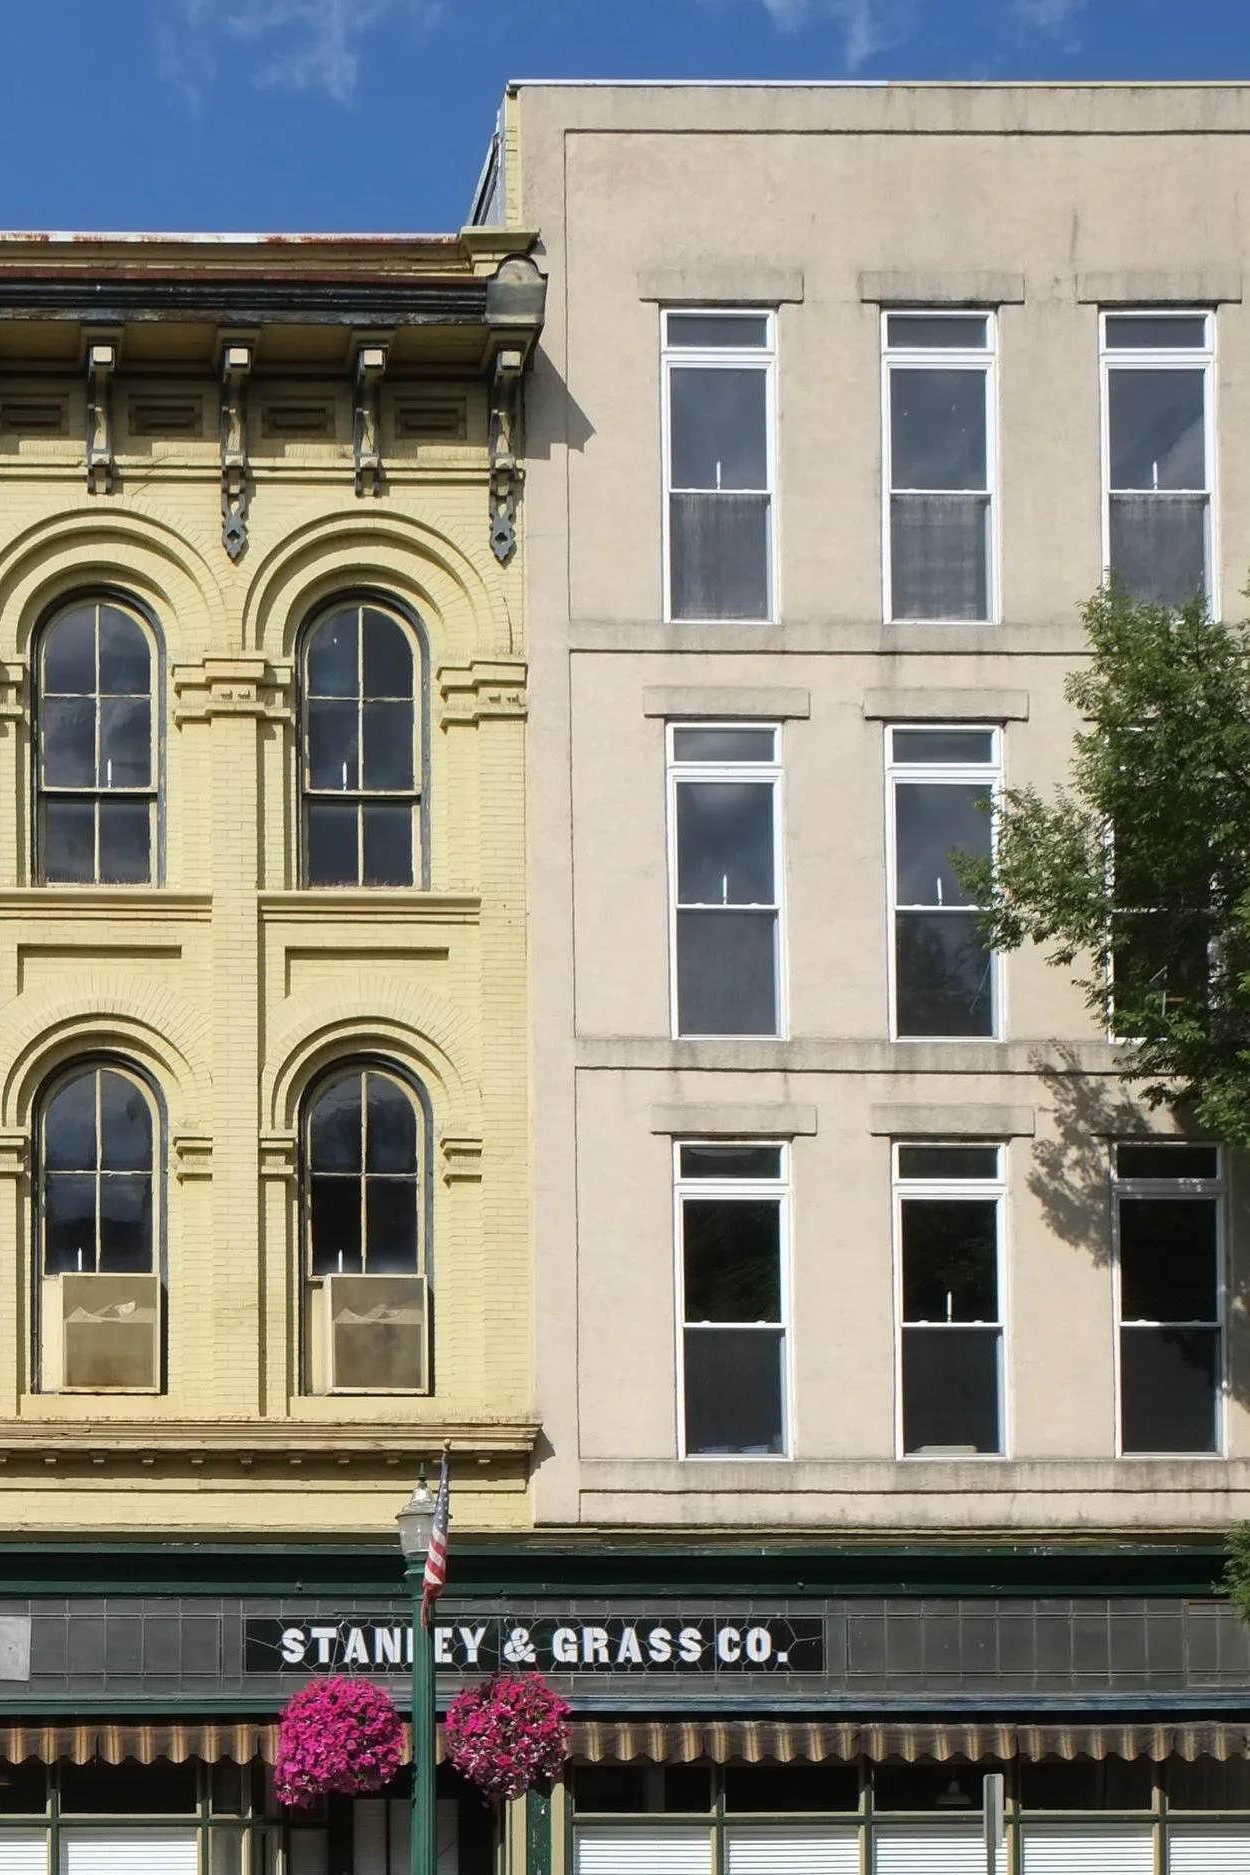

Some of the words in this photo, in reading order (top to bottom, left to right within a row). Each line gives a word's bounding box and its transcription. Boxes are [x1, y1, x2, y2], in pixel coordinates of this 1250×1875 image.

[504, 1627, 537, 1663] &
[552, 1627, 703, 1663] GRASS
[717, 1627, 789, 1662] CO.
